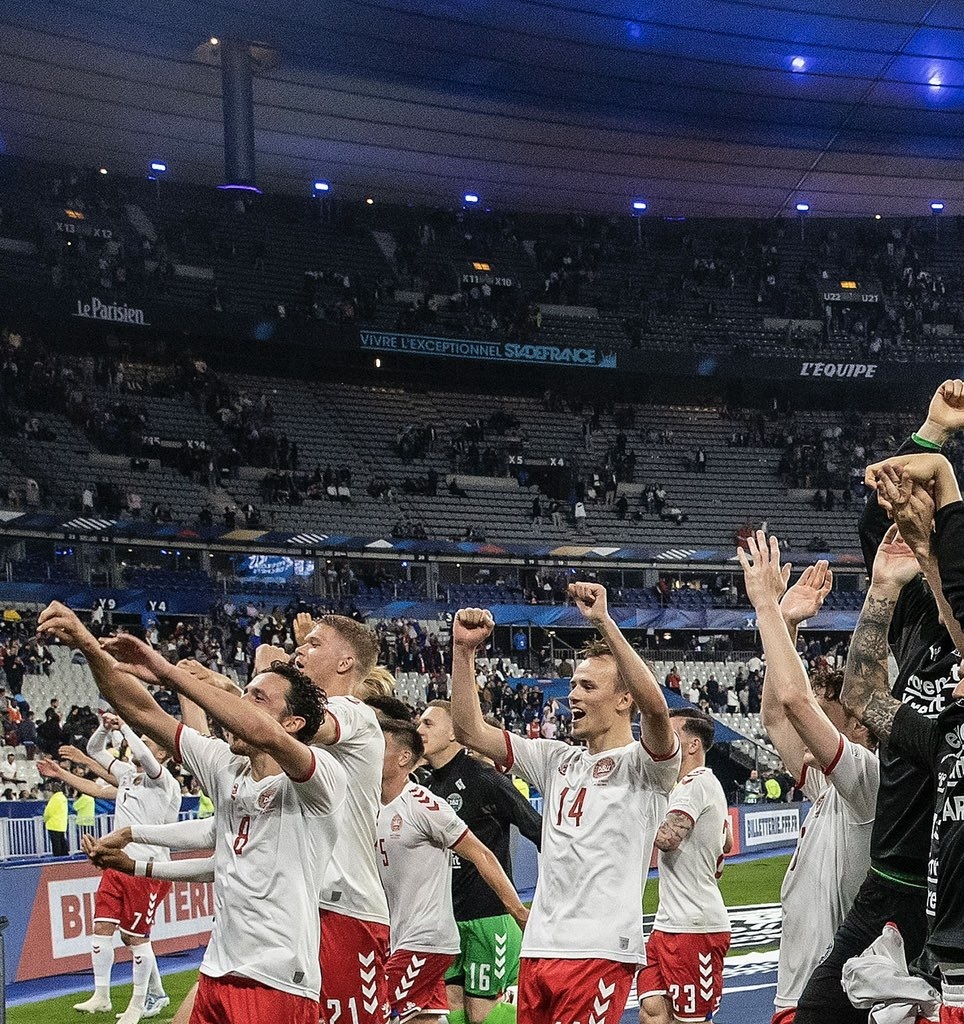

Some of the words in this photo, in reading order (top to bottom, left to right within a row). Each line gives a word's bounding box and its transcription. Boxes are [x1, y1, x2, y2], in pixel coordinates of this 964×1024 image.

[360, 333, 398, 348] VIVRE
[401, 337, 502, 357] L'EXCEPTIONNEL
[556, 786, 587, 827] 14
[233, 815, 251, 855] 8
[130, 911, 143, 930] 7
[469, 962, 491, 992] 16
[669, 984, 697, 1014] 23
